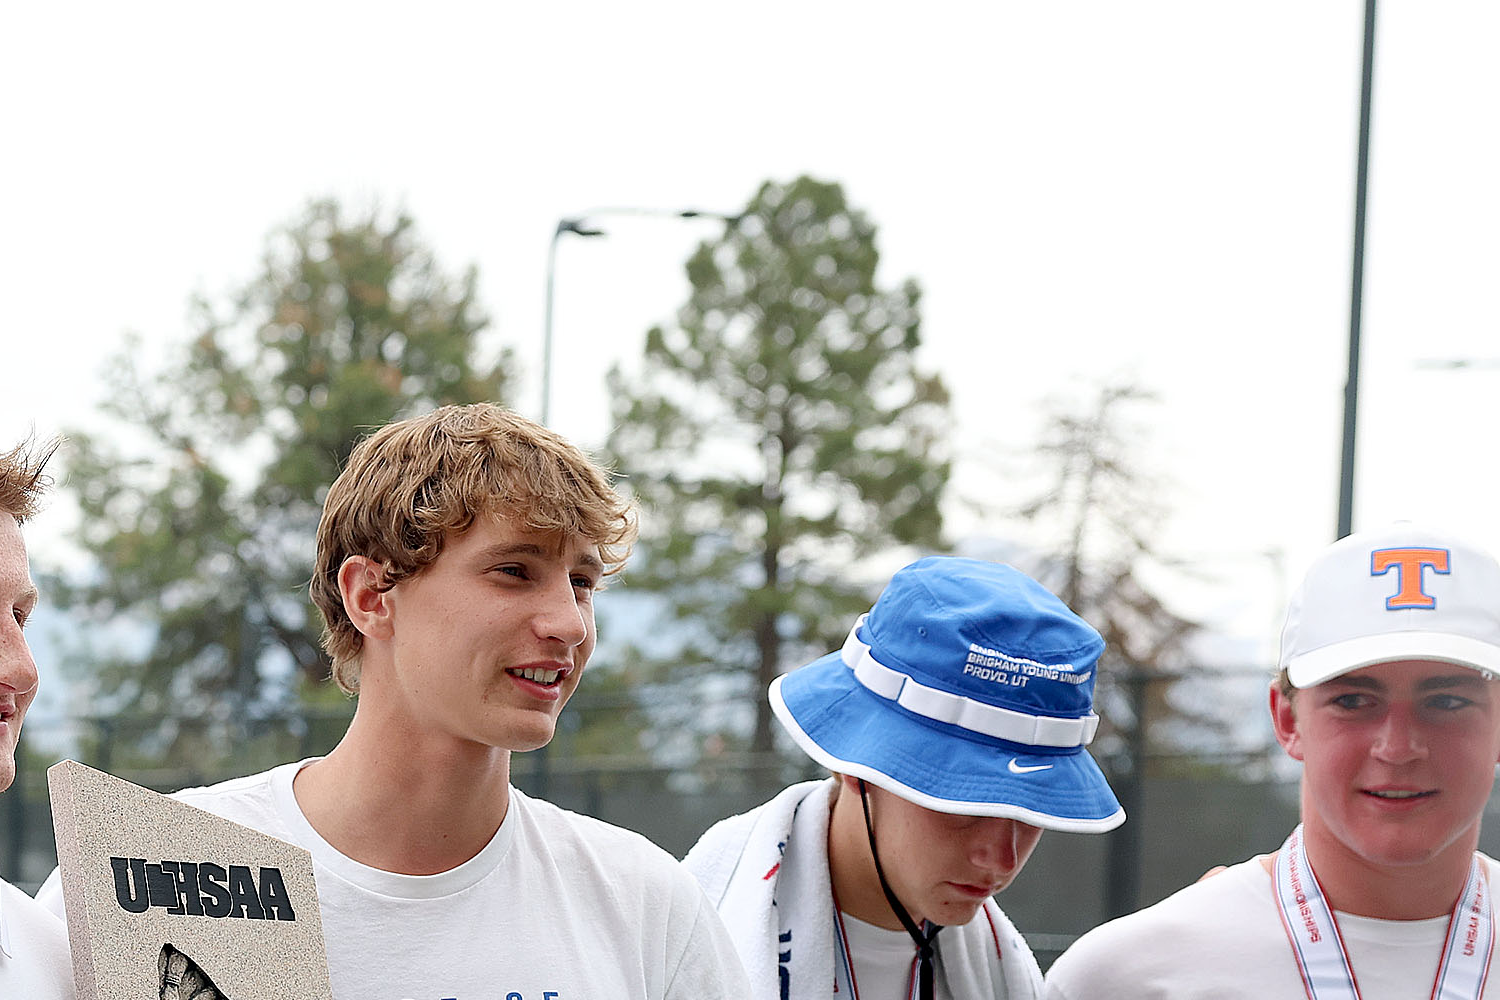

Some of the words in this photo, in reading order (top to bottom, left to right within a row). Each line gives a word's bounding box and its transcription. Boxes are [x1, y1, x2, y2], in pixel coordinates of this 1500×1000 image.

[1370, 547, 1451, 611] T
[967, 652, 1020, 674] BRIGHAM
[1021, 664, 1059, 681] YOUNG
[1011, 674, 1030, 688] UT
[109, 856, 297, 921] UHSAA
